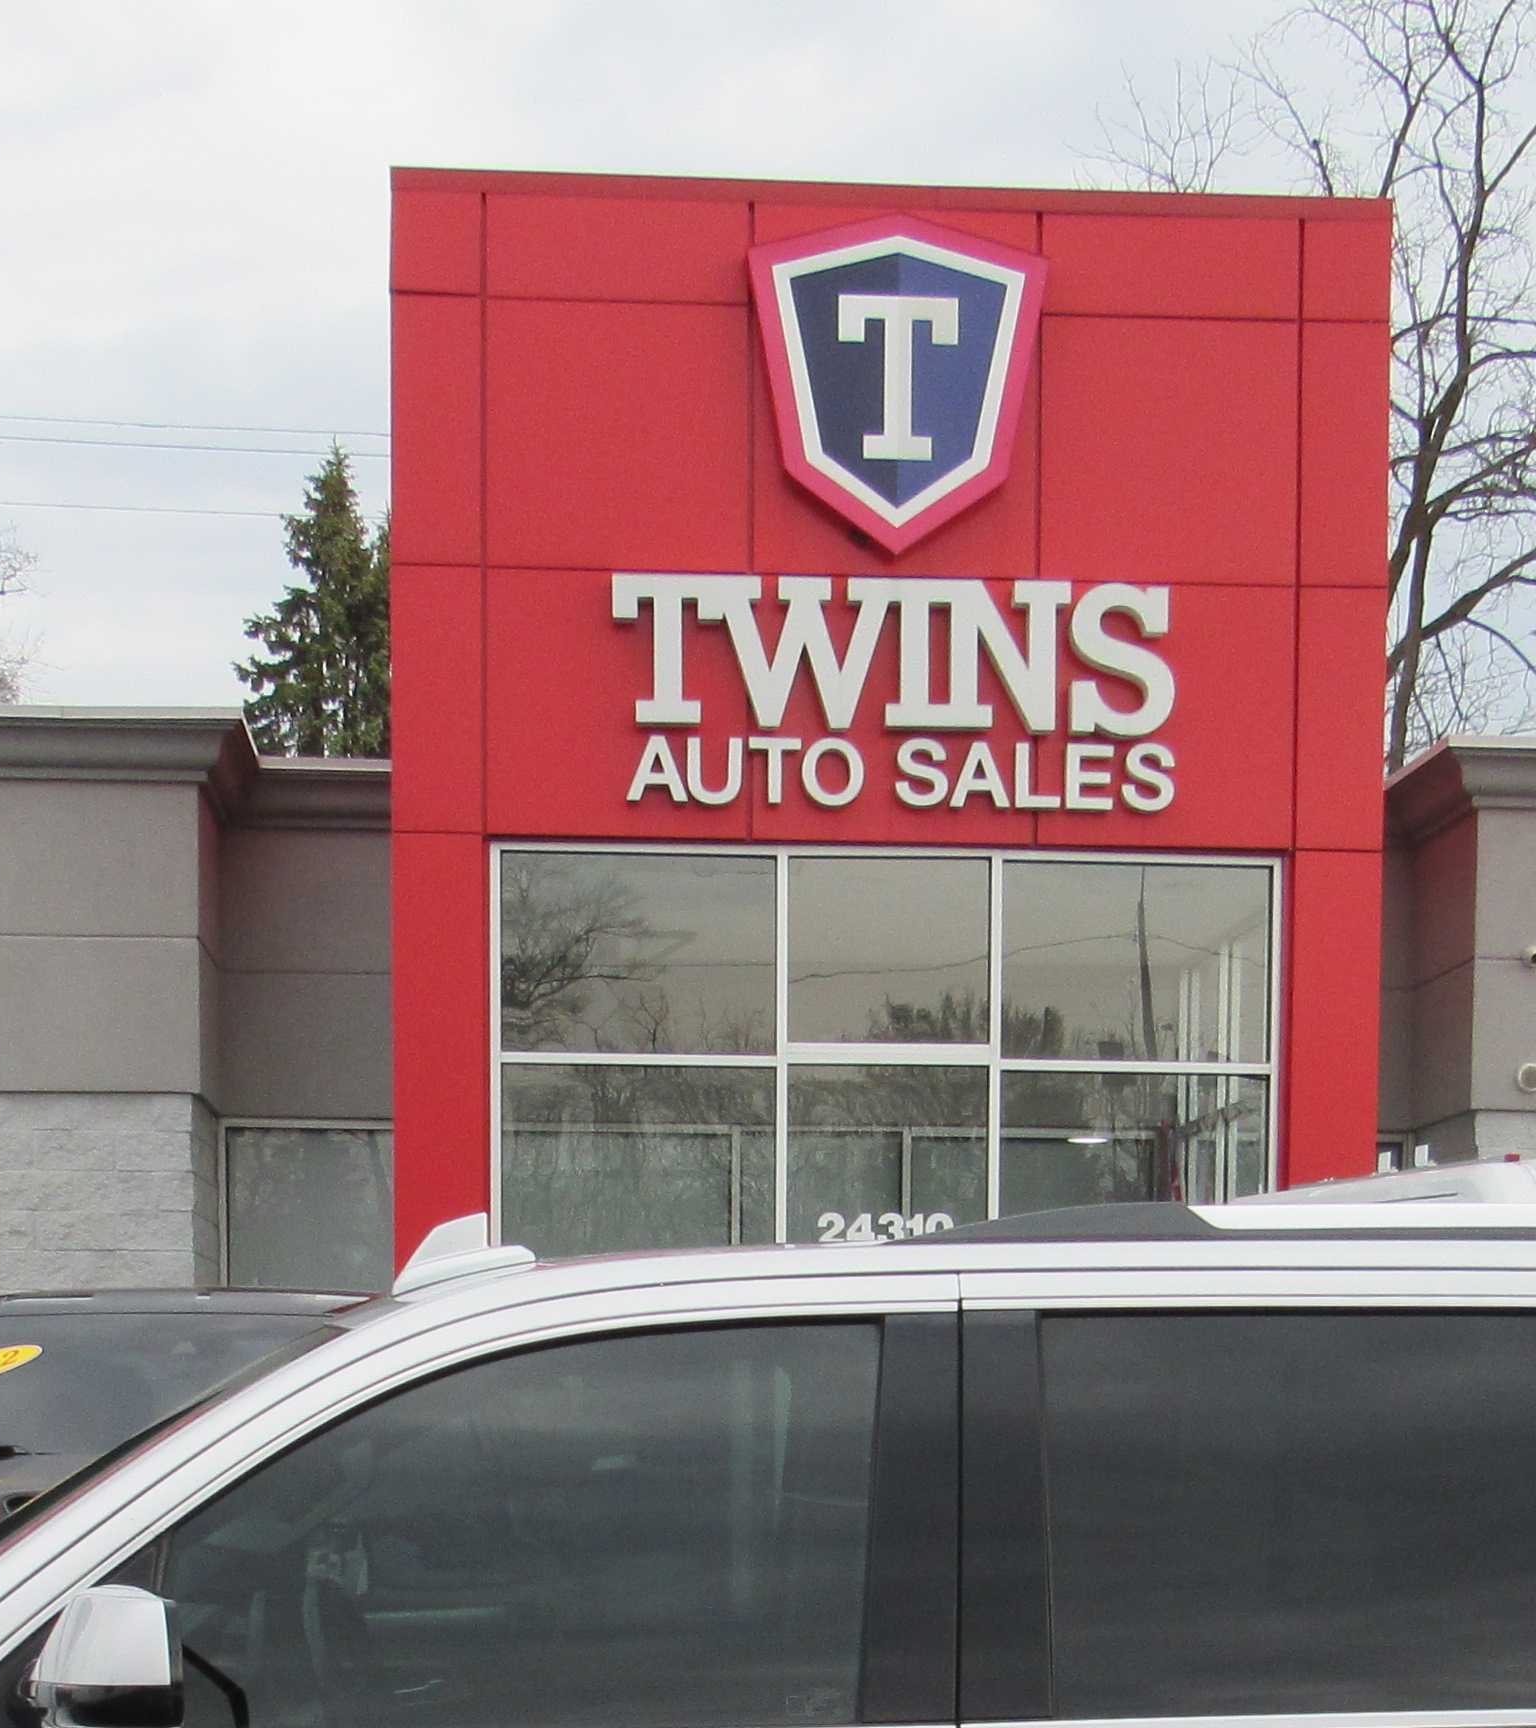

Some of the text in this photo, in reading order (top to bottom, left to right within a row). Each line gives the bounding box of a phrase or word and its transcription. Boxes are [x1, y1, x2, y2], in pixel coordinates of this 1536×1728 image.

[837, 293, 960, 461] T
[611, 572, 1176, 738] TWINS
[625, 734, 1176, 814] AUTO SALES
